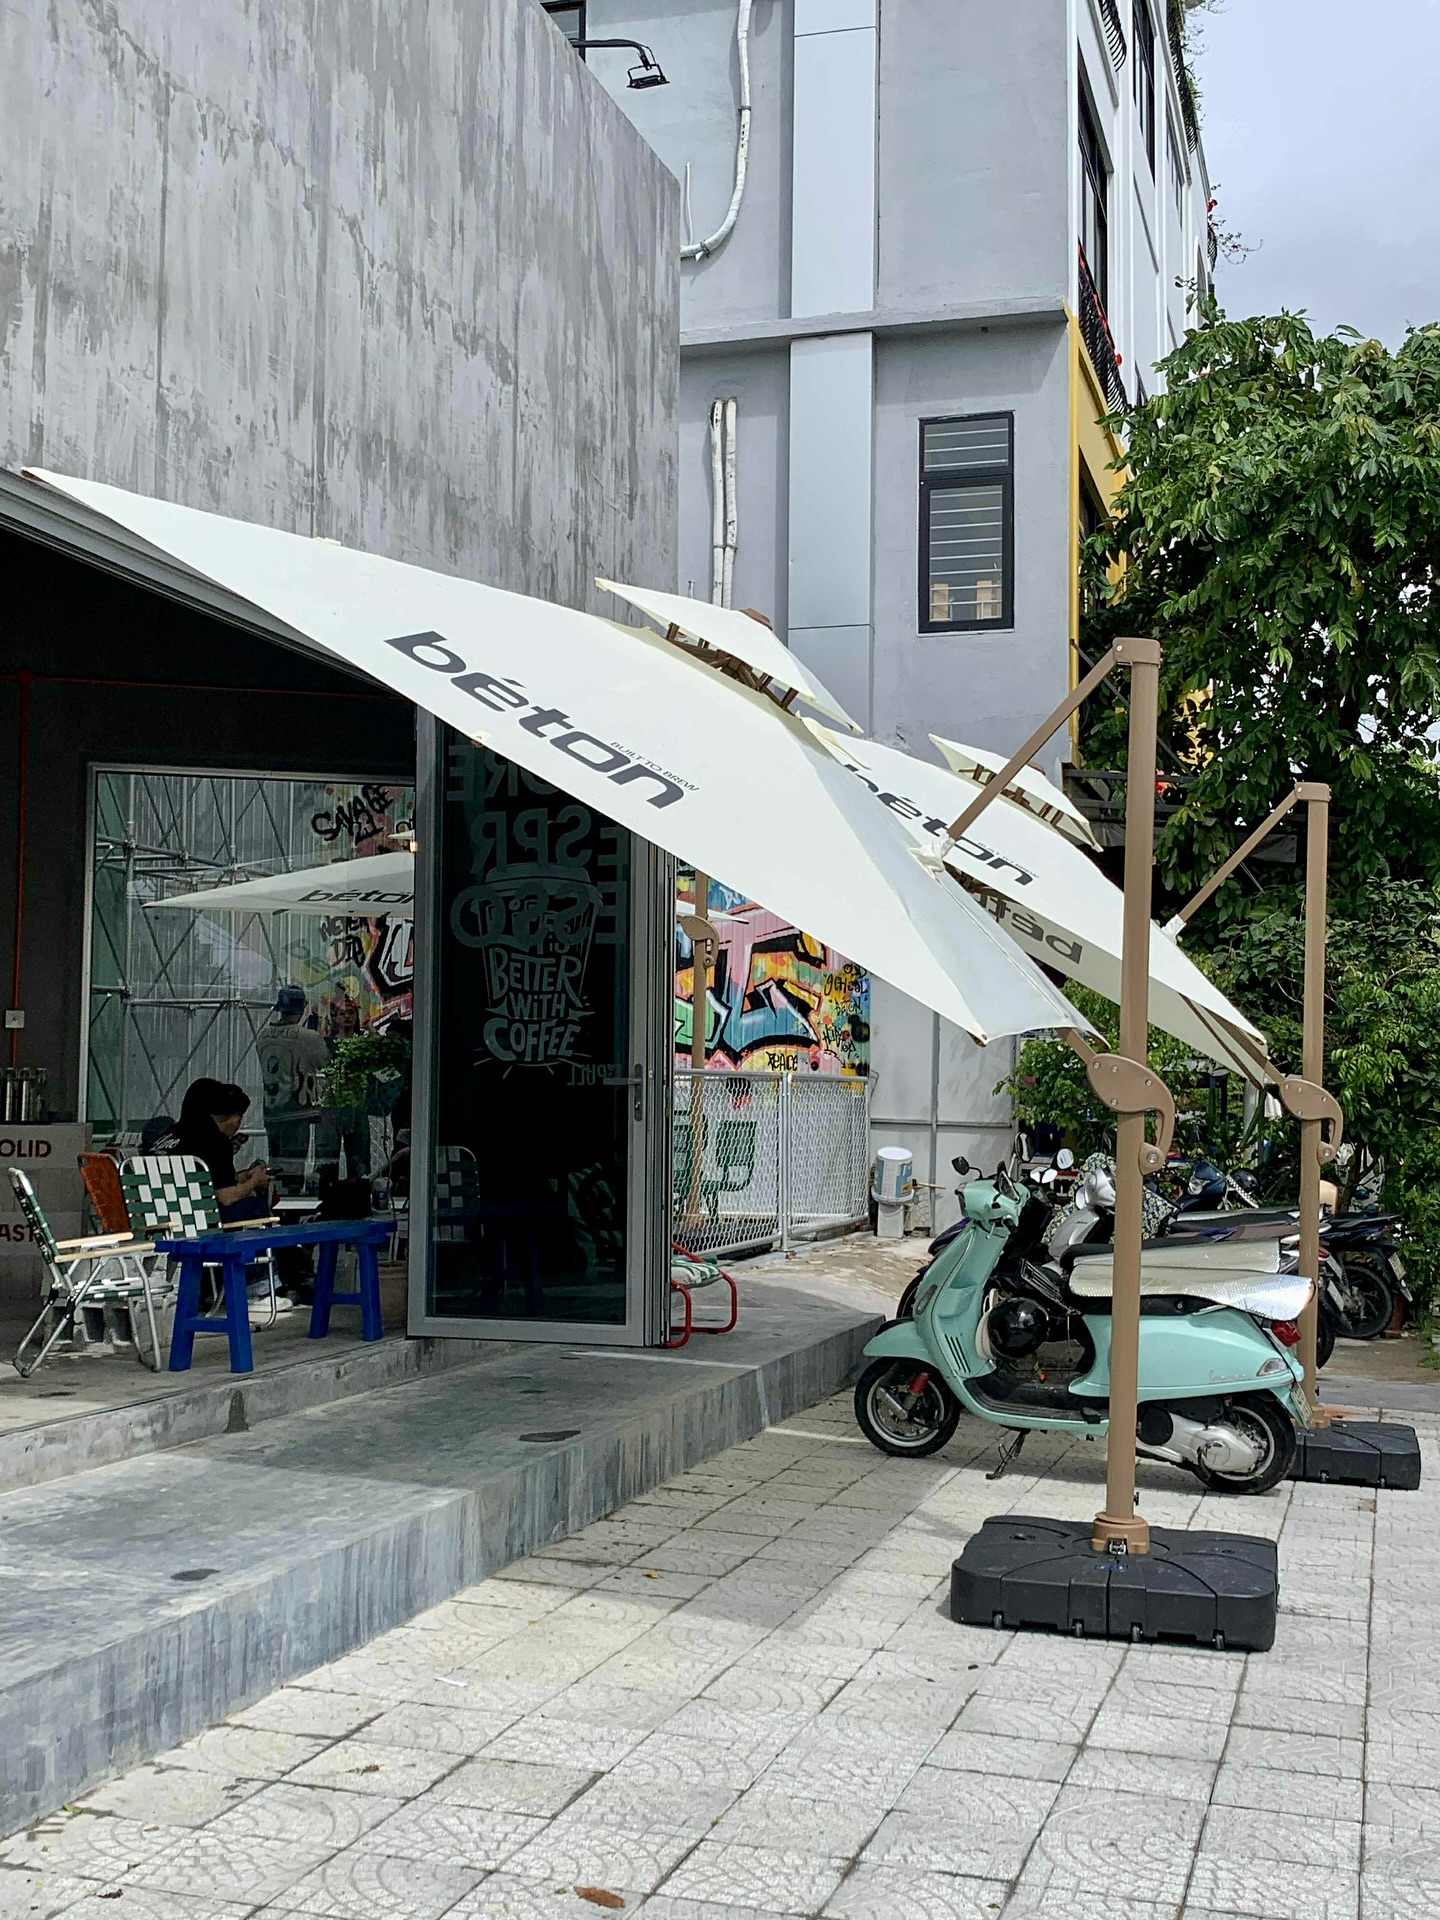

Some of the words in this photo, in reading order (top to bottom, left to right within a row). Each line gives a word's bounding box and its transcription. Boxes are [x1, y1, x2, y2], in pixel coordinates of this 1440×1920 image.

[384, 631, 684, 809] béton
[610, 742, 644, 761] BUILT
[645, 760, 662, 772] TO
[663, 771, 699, 791] BREW
[489, 947, 583, 1008] BETTER
[483, 1018, 581, 1061] COFFEE
[0, 1139, 52, 1158] OLID
